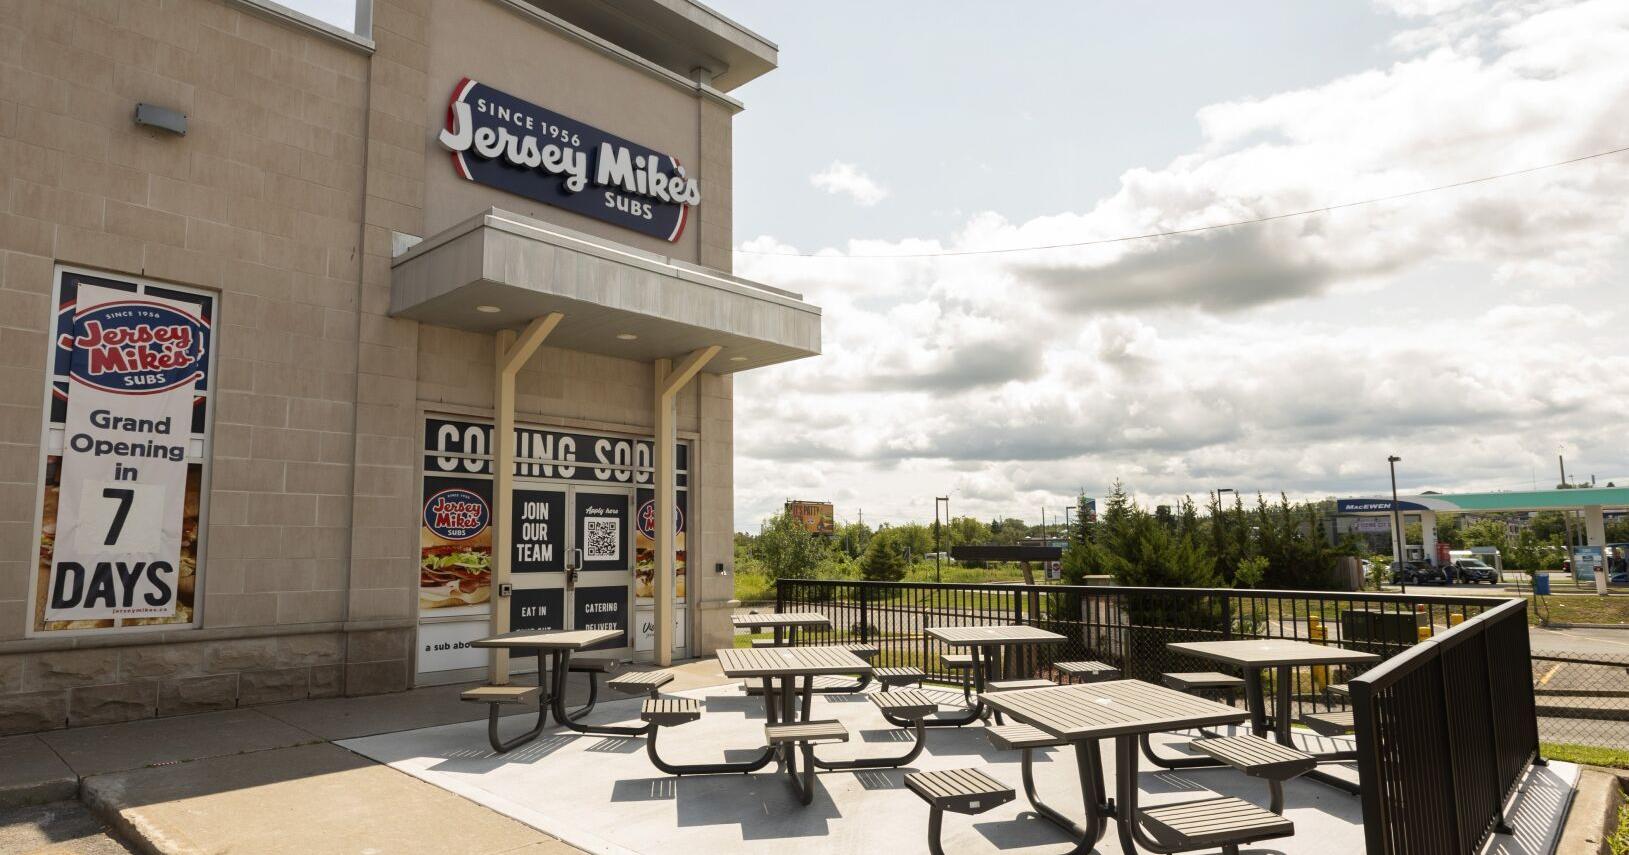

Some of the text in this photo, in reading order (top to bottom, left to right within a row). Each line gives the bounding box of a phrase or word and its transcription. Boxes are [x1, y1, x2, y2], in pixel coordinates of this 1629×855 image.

[477, 99, 581, 147] SINCE 1956
[439, 100, 588, 192] Jersey
[604, 190, 653, 220] SUBS
[105, 311, 133, 319] SINCE
[75, 320, 193, 349] Jersey
[89, 344, 194, 375] Mike's
[124, 374, 166, 386] SUBS
[90, 410, 171, 435] Grand
[70, 433, 184, 462] Opening
[594, 438, 656, 483] SOO
[114, 462, 138, 481] in
[102, 487, 135, 546] 7
[433, 497, 482, 518] Jersey
[521, 501, 549, 520] JOIN
[585, 505, 619, 516] Apply here
[522, 522, 548, 541] OUR
[516, 543, 553, 562] TEAM
[51, 560, 174, 609] DAYS
[521, 605, 547, 617] EAT IN
[585, 602, 618, 614] CATERING
[585, 622, 617, 631] DELIVERY
[434, 642, 450, 651] sub
[453, 641, 471, 649] abo
